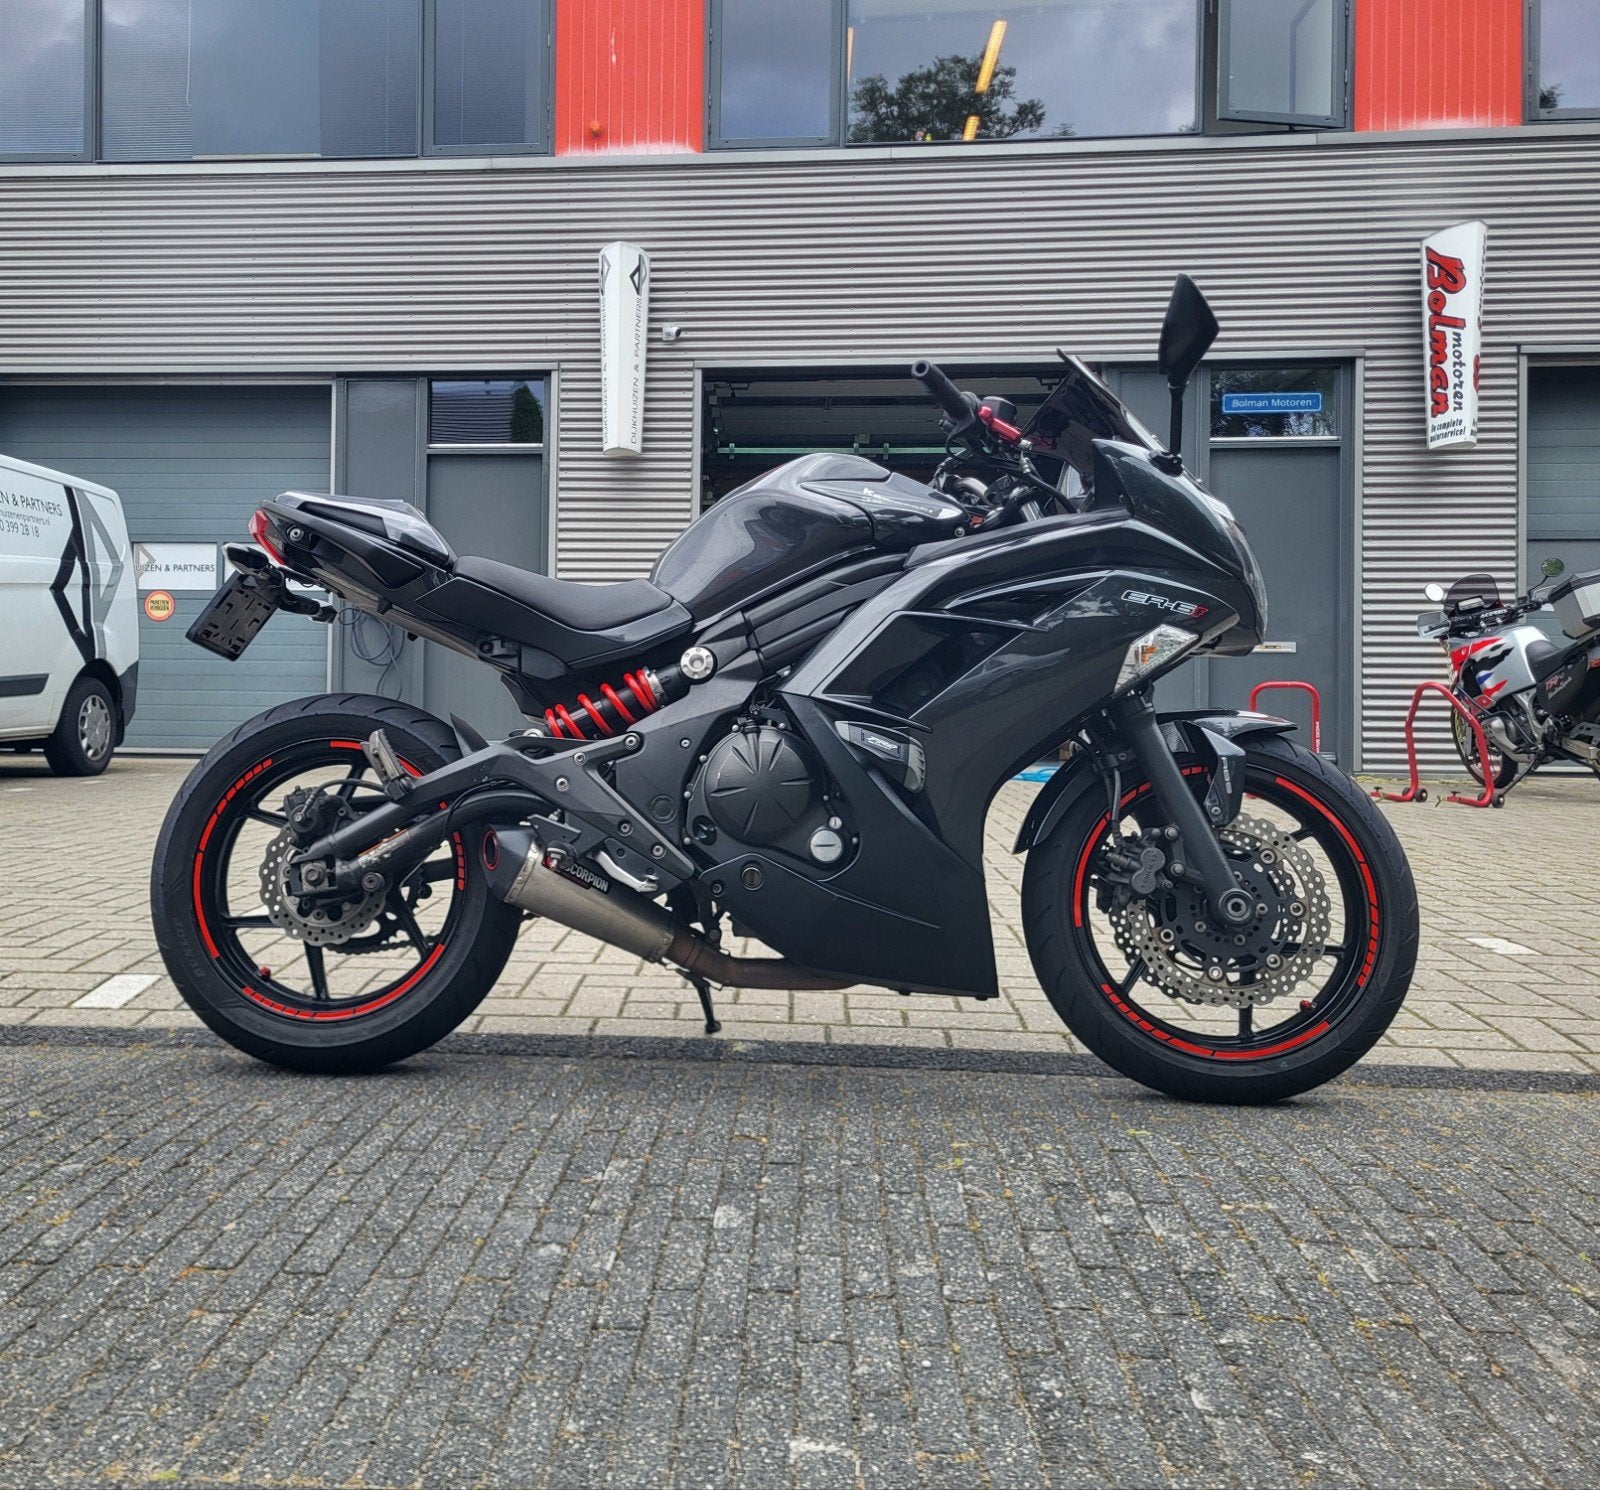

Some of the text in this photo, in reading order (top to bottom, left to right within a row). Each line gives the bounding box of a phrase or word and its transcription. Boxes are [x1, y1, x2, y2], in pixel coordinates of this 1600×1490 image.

[1425, 246, 1466, 418] Bolman
[631, 297, 642, 444] DIJKHUIZEN & PARTNERS
[1452, 331, 1465, 412] motoren
[1232, 398, 1312, 408] Bolman Motoren
[1437, 418, 1463, 431] complete
[11, 493, 19, 507] &
[20, 495, 63, 517] PARTNERS
[6, 520, 19, 534] 399
[20, 523, 30, 536] 28
[31, 526, 40, 538] 18
[164, 564, 171, 572] &
[173, 564, 215, 572] PARTNERS
[565, 863, 610, 892] CORPION
